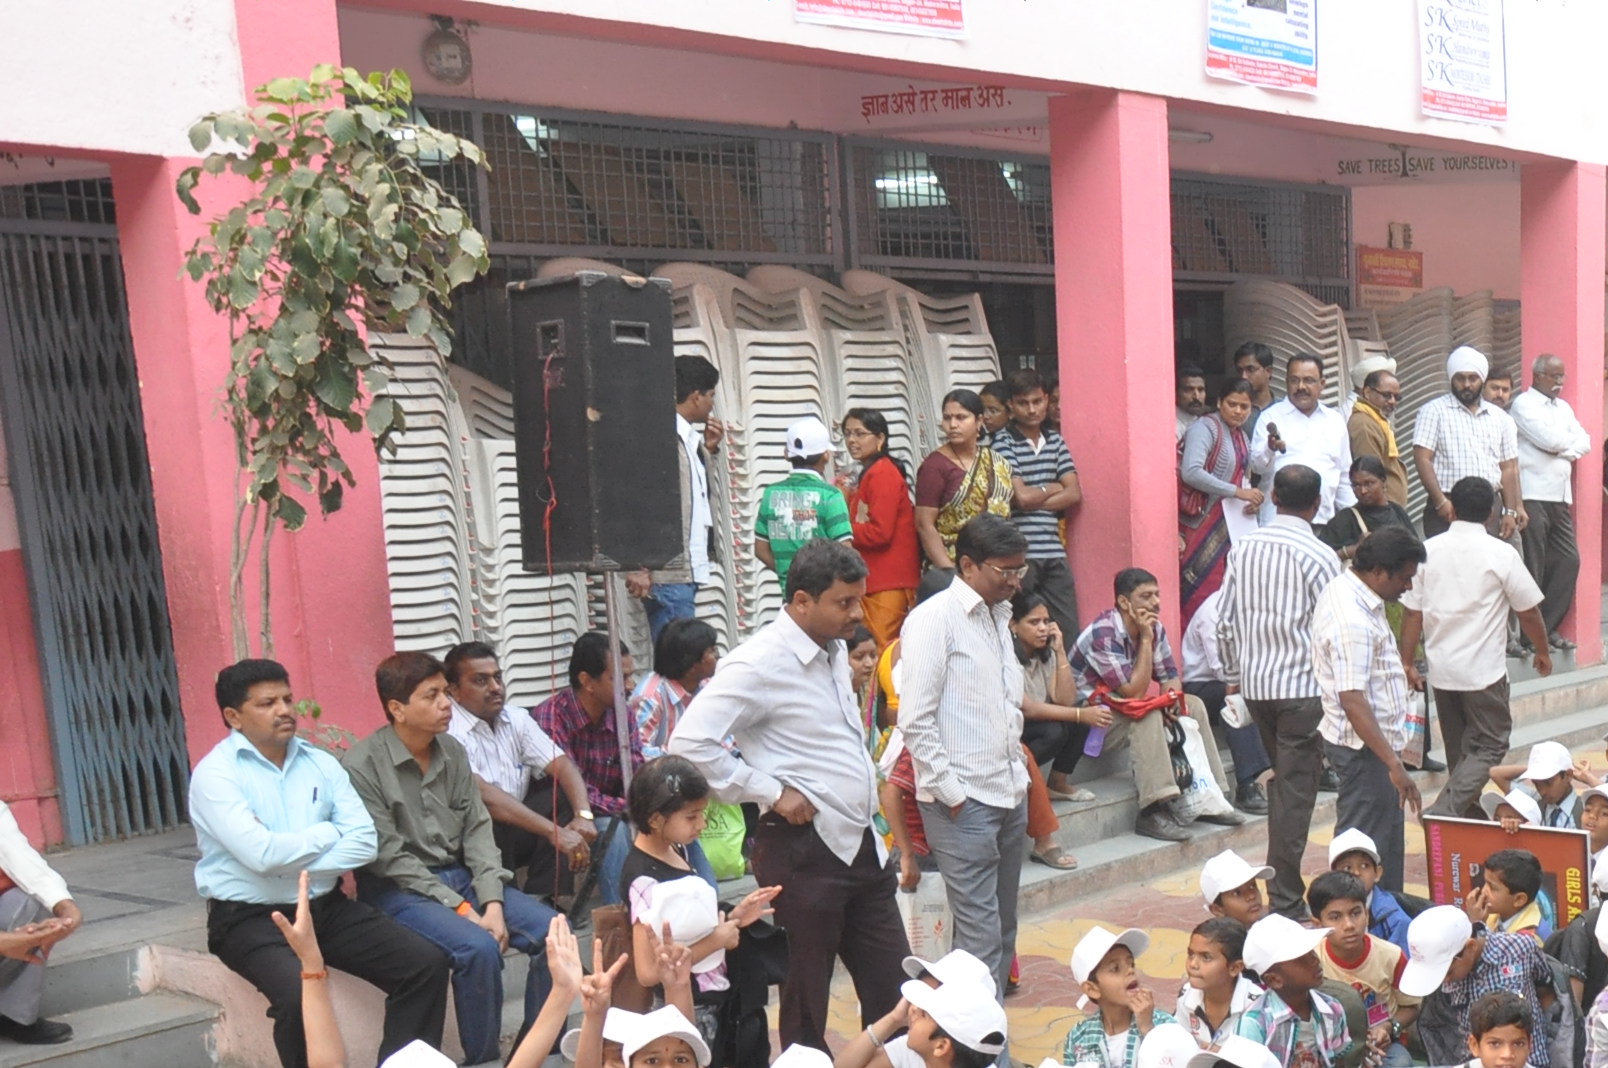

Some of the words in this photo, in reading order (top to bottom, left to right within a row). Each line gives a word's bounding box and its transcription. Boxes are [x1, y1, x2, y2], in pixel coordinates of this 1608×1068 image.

[920, 89, 938, 113] तर
[941, 86, 974, 110] मान
[1337, 160, 1362, 175] SAVE
[1367, 157, 1400, 175] TREES
[1408, 156, 1436, 172] SAVE
[1565, 867, 1582, 904] GIRLS
